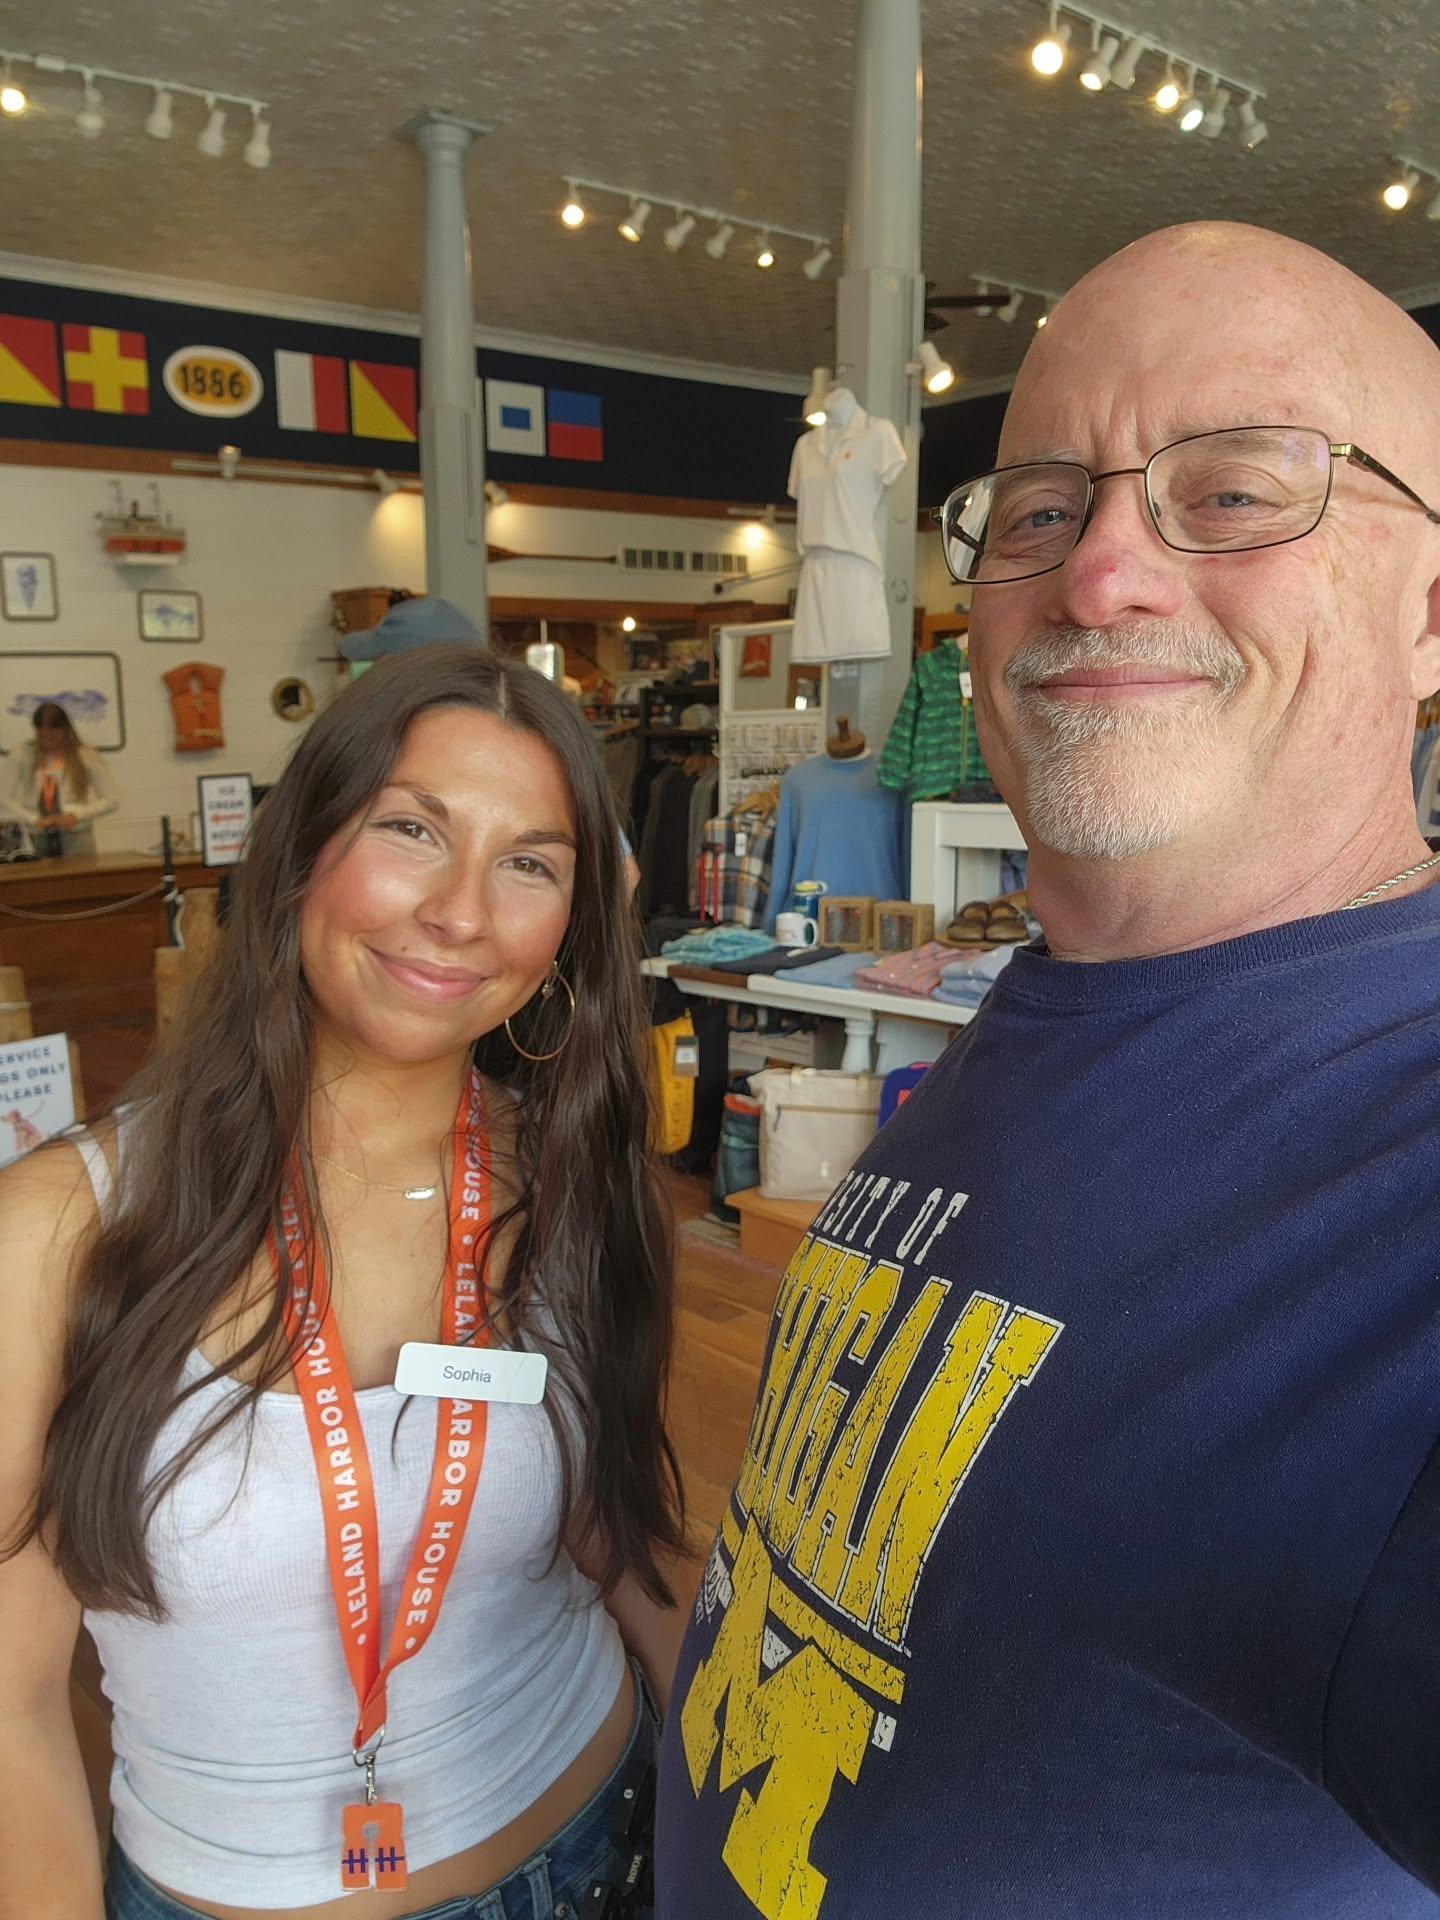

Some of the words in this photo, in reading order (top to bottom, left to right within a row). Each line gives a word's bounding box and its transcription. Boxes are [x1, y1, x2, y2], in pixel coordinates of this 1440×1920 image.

[180, 363, 243, 400] 1886
[27, 1062, 65, 1079] ONLY
[896, 1187, 970, 1266] OF
[443, 1365, 492, 1385] Sophia
[315, 1386, 361, 1511] HARBOR
[439, 1398, 473, 1508] ARBOR
[337, 1522, 369, 1629] LELAND
[405, 1521, 455, 1628] HOUSE
